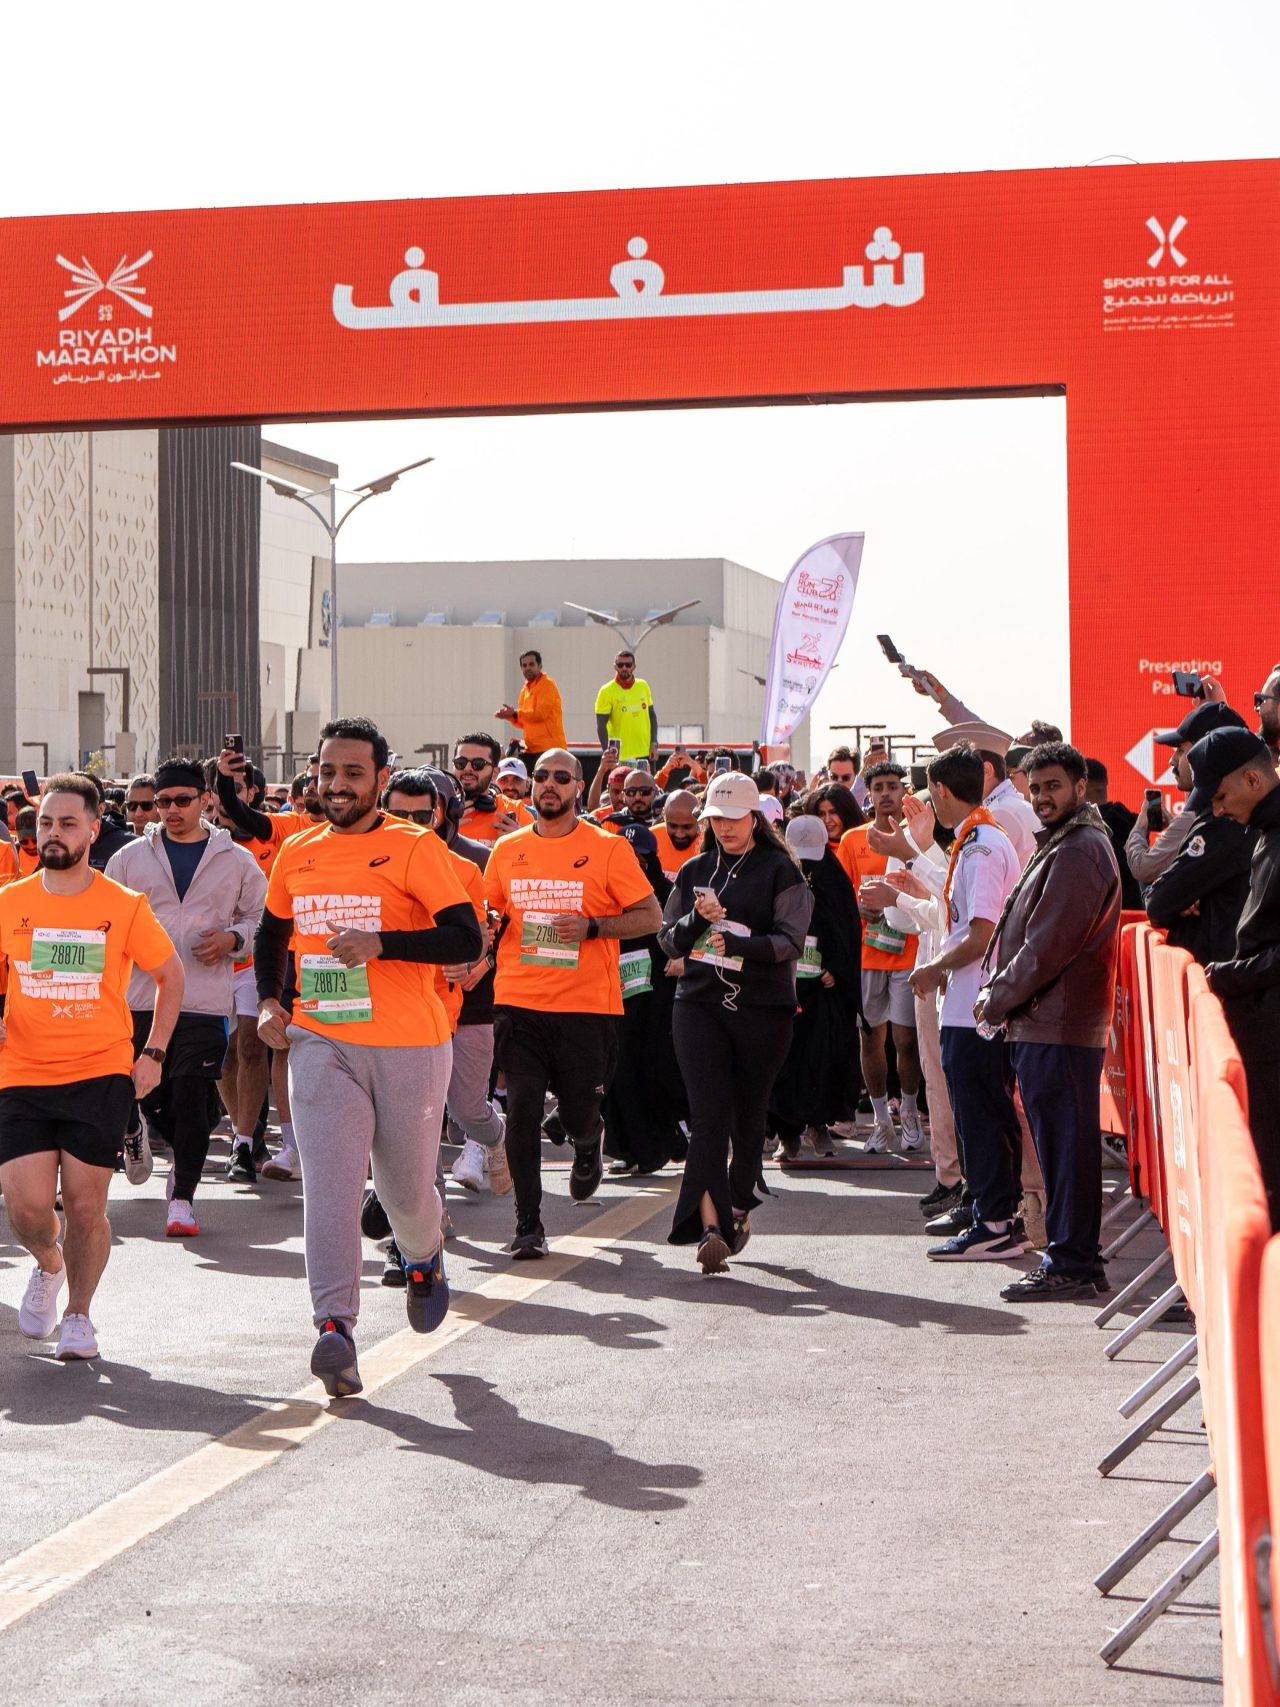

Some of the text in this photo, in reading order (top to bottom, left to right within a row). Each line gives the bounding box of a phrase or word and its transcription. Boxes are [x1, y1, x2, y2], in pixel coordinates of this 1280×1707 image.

[332, 226, 925, 330] شغف
[1103, 273, 1233, 289] SPORTS FOR ALL
[59, 327, 152, 348] RIYADH
[36, 345, 177, 367] MARATHON
[1139, 659, 1222, 675] Presenting
[510, 879, 584, 893] RIYADH
[511, 889, 584, 902] MARATHON
[293, 894, 381, 914] RIYADH
[513, 897, 584, 912] RUNNER
[294, 906, 381, 927] MARATHON
[51, 944, 85, 966] 28870
[21, 984, 100, 1000] RUNNER
[314, 972, 347, 993] 28873
